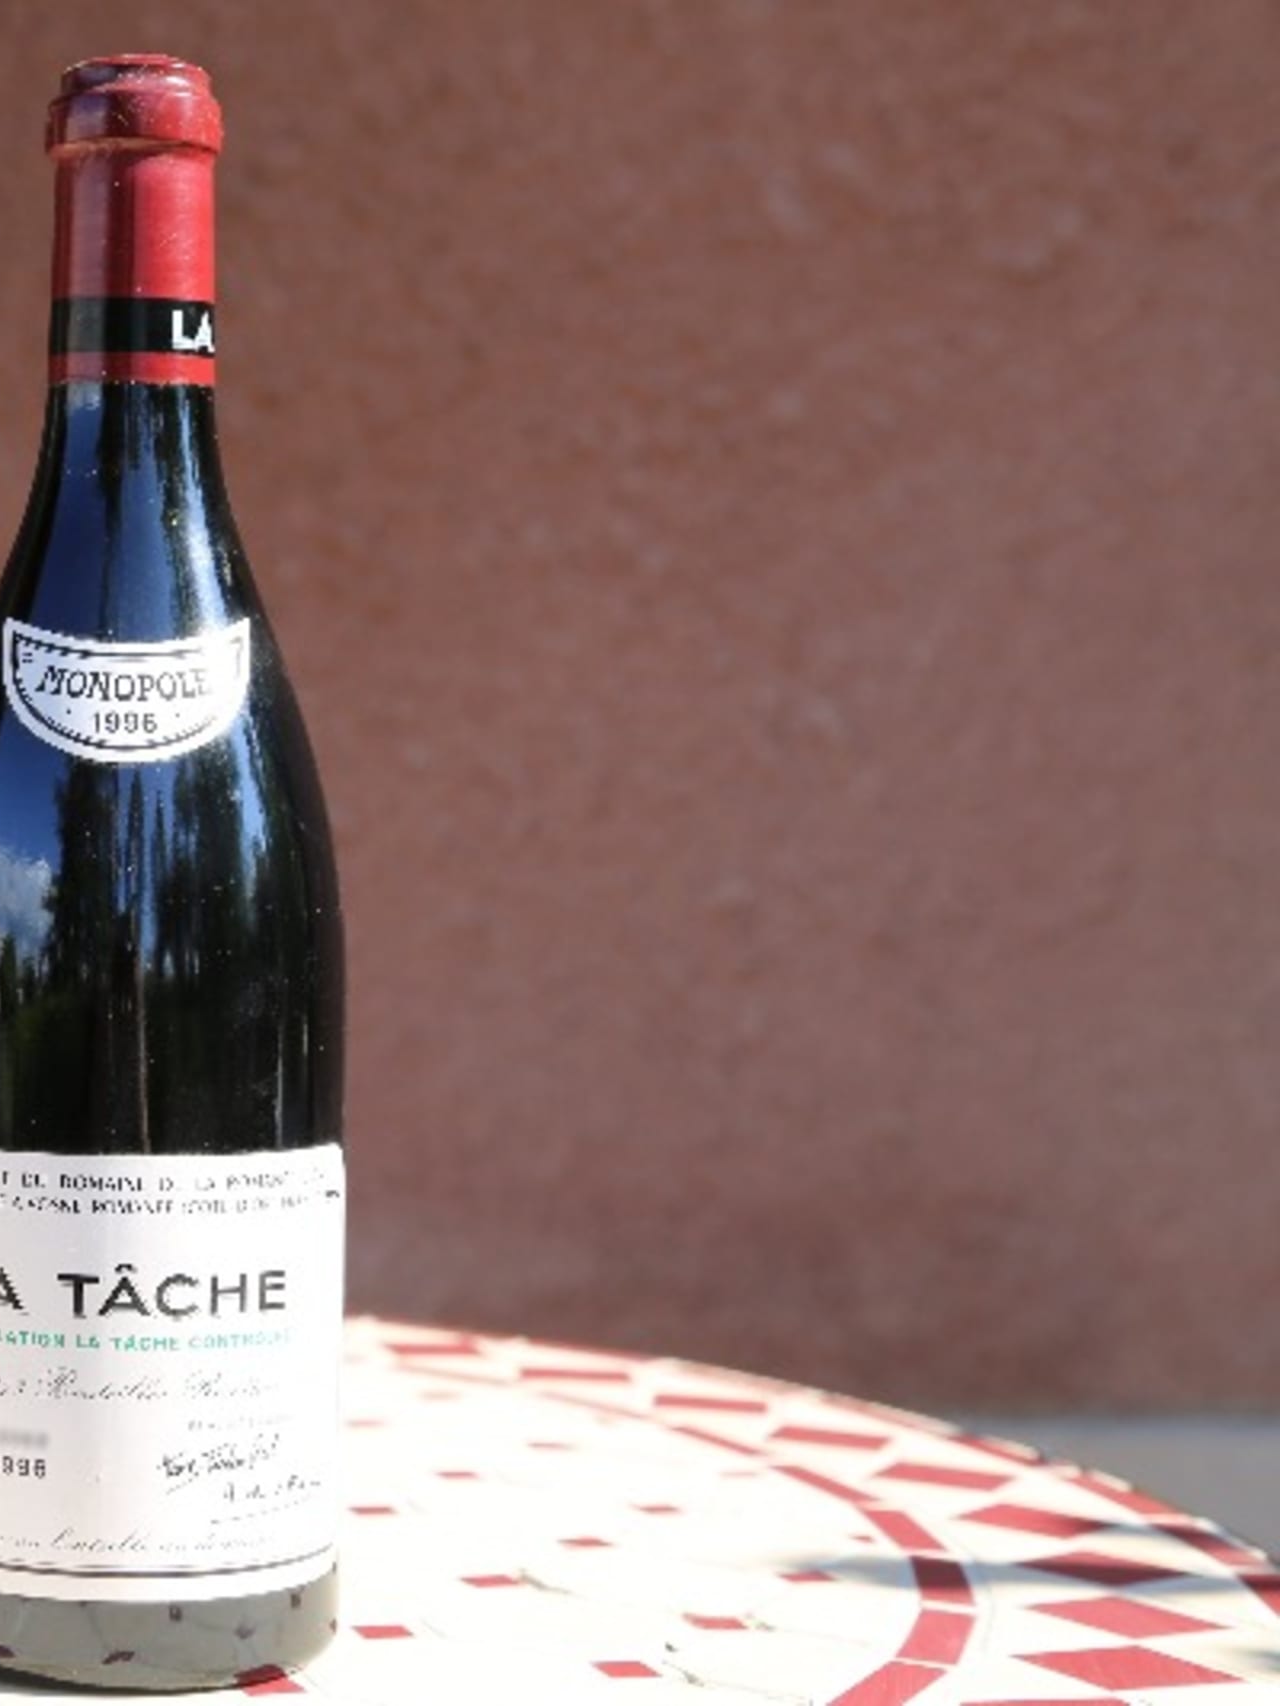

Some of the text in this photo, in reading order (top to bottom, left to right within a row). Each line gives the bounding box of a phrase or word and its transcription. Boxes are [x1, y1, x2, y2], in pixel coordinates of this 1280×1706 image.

[171, 309, 215, 352] LA
[35, 665, 214, 702] MONOPOLE
[93, 712, 158, 734] 1996
[57, 1263, 287, 1318] TÂCHE
[76, 1335, 100, 1348] LA
